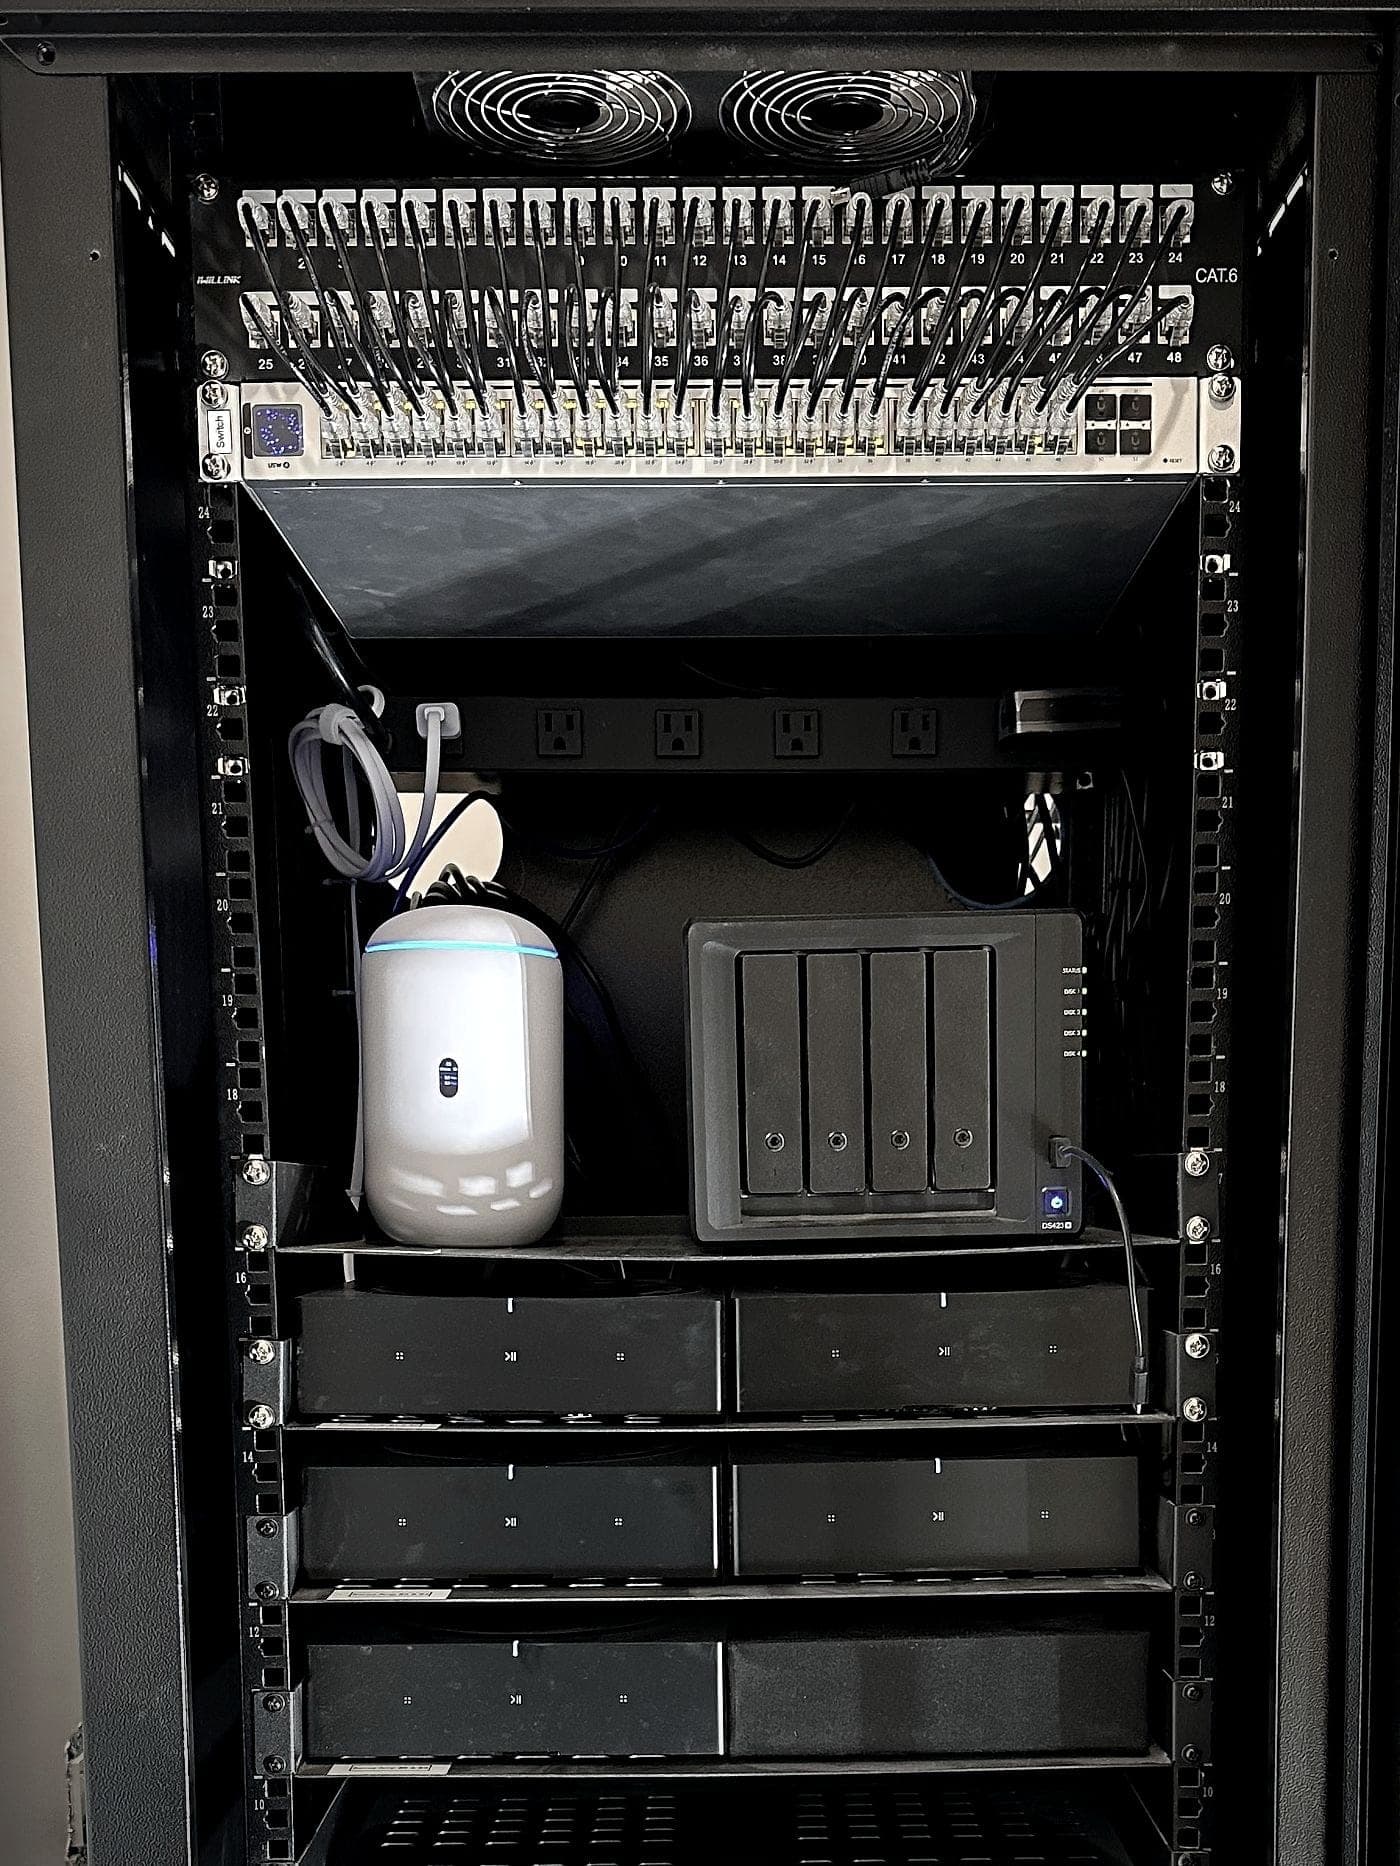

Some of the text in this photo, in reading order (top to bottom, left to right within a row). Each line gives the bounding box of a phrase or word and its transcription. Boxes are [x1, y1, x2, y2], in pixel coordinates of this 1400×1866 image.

[654, 255, 666, 266] 11
[692, 255, 707, 266] 12
[733, 255, 747, 266] 13
[772, 254, 786, 266] 14
[812, 254, 827, 265] 15
[854, 254, 866, 265] 16
[891, 254, 905, 265] 17
[931, 253, 945, 264] 18
[970, 253, 985, 264] 19
[1010, 253, 1025, 264] 20
[1050, 253, 1064, 264] 21
[1090, 253, 1104, 264] 22
[1128, 252, 1143, 264] 23
[1168, 252, 1182, 263] 24
[1195, 268, 1238, 283] CAT.6
[497, 357, 510, 368] 31
[654, 355, 669, 366] 35
[693, 355, 709, 366] 36
[892, 354, 906, 365] 41
[971, 353, 985, 364] 43
[1127, 352, 1142, 363] 47
[1166, 352, 1182, 363] 48
[258, 359, 273, 369] 25
[216, 415, 225, 448] Switch
[198, 506, 210, 518] 24
[1229, 501, 1241, 513] 24
[1227, 600, 1239, 612] 23
[202, 606, 214, 618] 23
[207, 704, 218, 717] 22
[1225, 699, 1237, 711] 22
[1222, 797, 1233, 809] 21
[211, 803, 223, 815] 21
[1219, 893, 1231, 905] 20
[216, 899, 228, 911] 20
[1217, 988, 1228, 1000] 19
[222, 994, 233, 1007] 19
[1214, 1081, 1226, 1093] 18
[227, 1088, 238, 1100] 18
[1210, 1263, 1222, 1275] 16
[236, 1272, 247, 1284] 16
[1206, 1441, 1218, 1453] 14
[242, 1451, 254, 1463] 14
[1204, 1616, 1215, 1626] 12
[249, 1627, 260, 1637] 12
[1202, 1787, 1213, 1797] 10
[254, 1799, 264, 1810] 10
